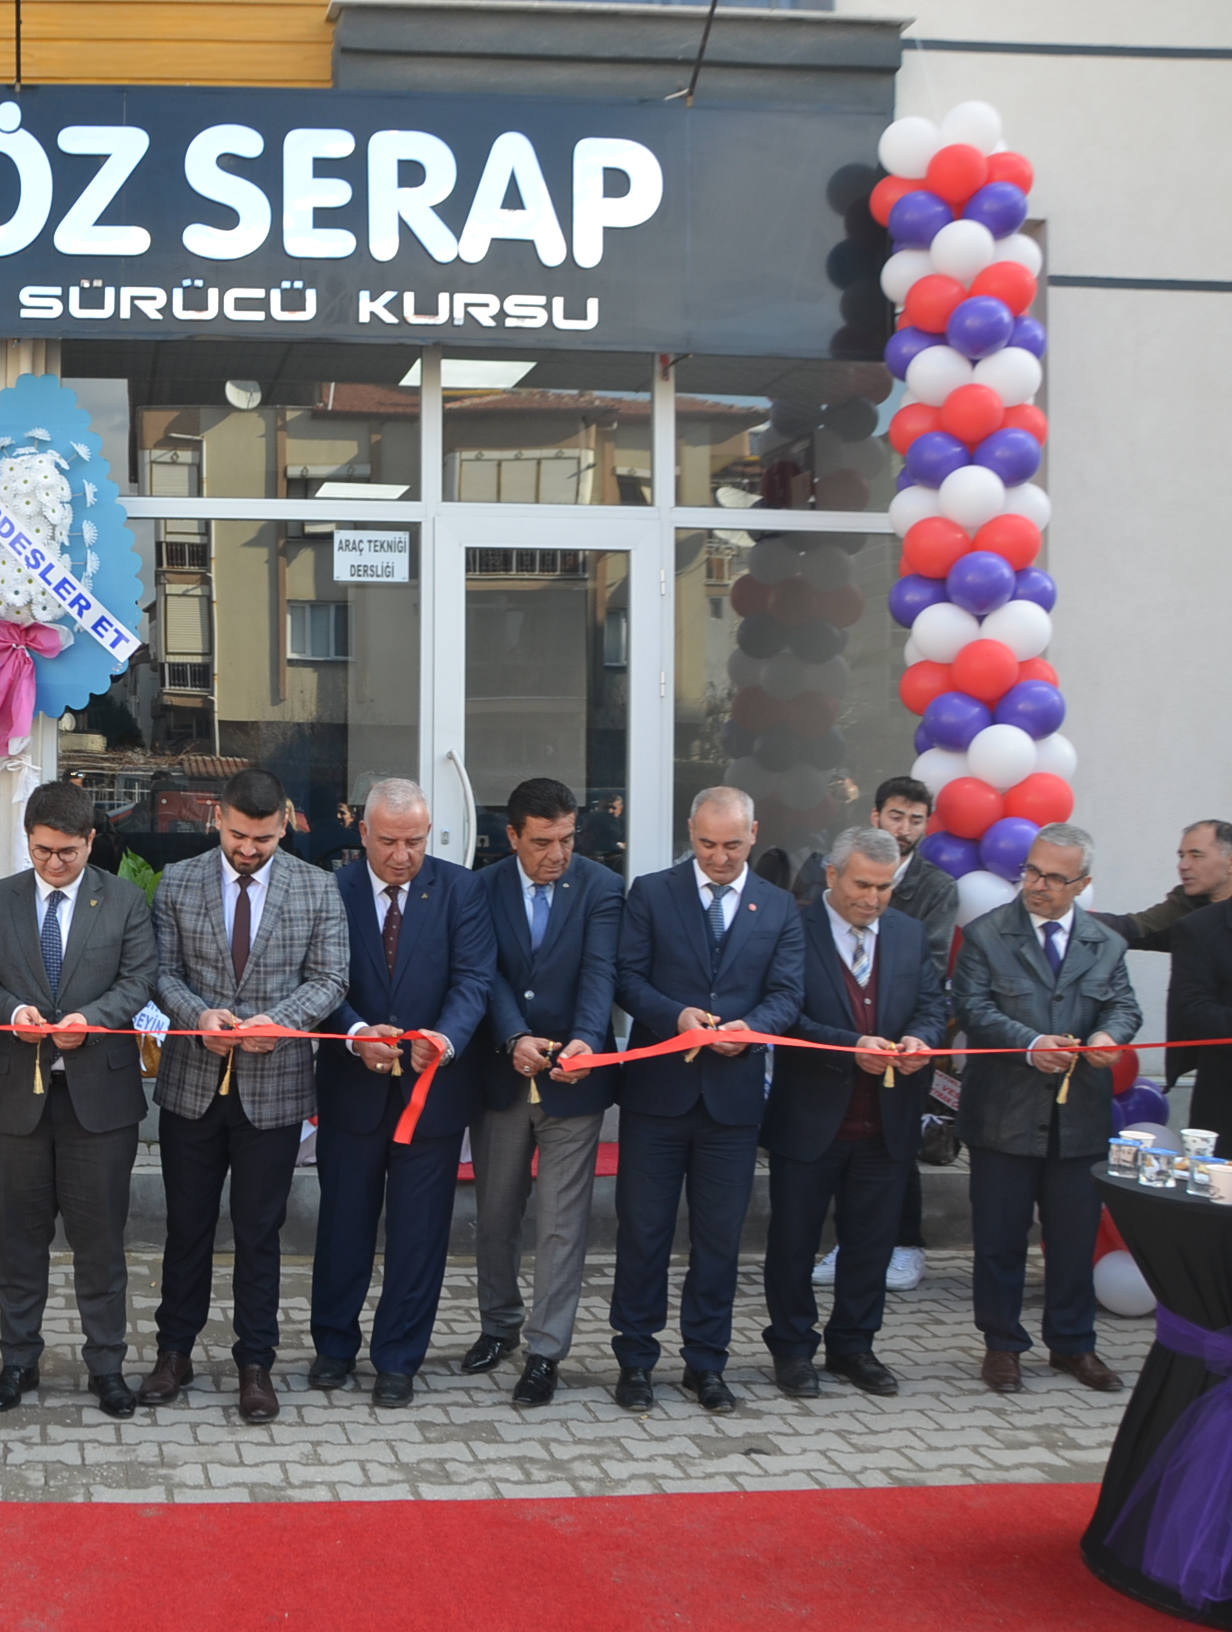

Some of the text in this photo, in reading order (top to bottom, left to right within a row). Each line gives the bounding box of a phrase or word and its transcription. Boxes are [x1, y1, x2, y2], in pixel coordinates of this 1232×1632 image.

[181, 124, 664, 268] SERAP
[18, 278, 600, 331] SÜRÜCÜ KURSU
[337, 536, 407, 556] ARAÇ TEKNİĞİ
[350, 561, 395, 578] DERSLİĞİ
[90, 615, 131, 650] ET
